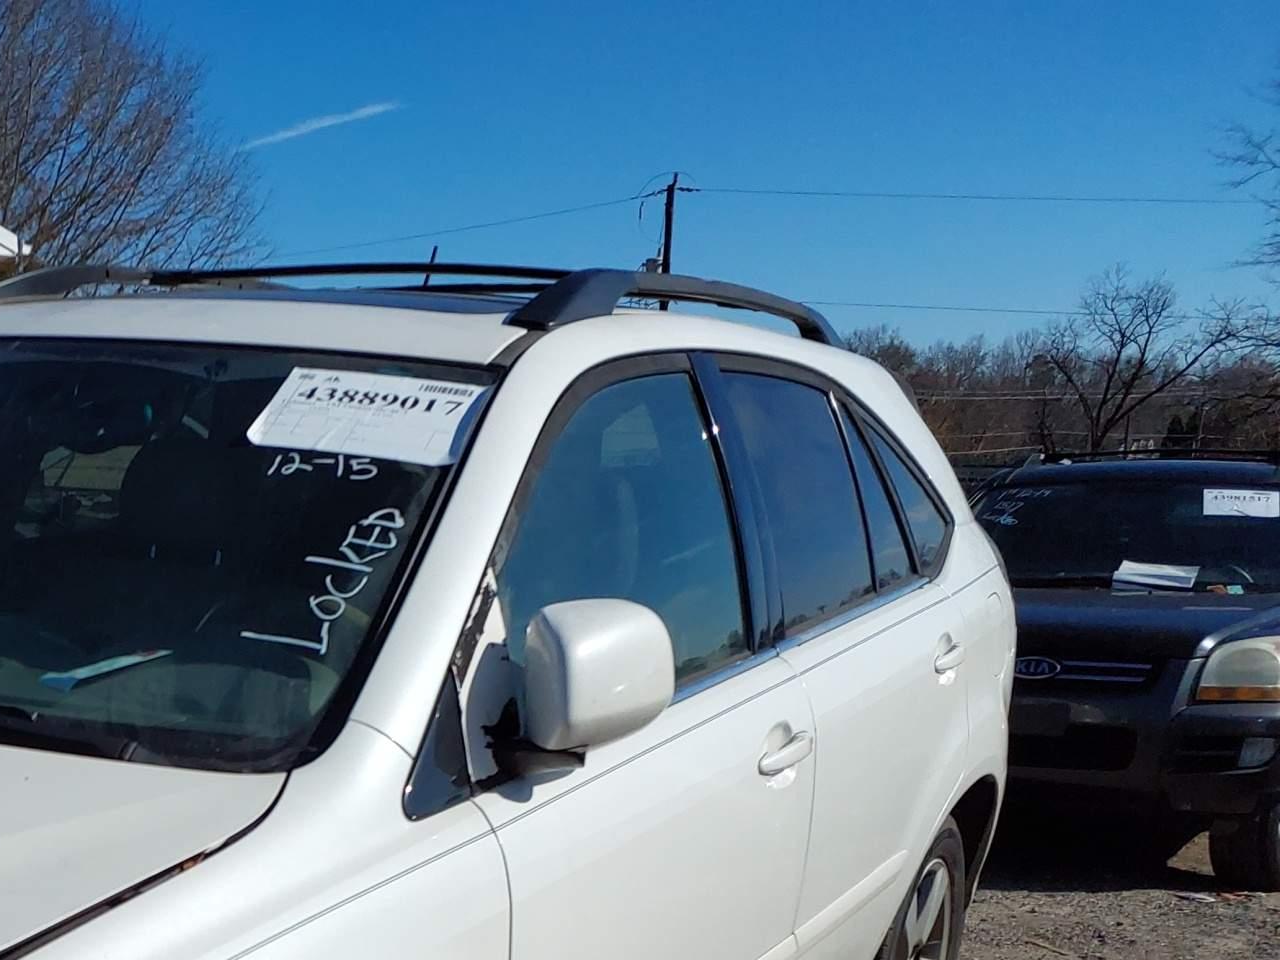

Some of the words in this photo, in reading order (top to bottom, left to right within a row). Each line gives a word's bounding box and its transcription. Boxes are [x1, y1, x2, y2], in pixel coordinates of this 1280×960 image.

[298, 386, 464, 416] 43889017
[267, 452, 378, 480] 12-15
[1016, 660, 1049, 674] KIA
